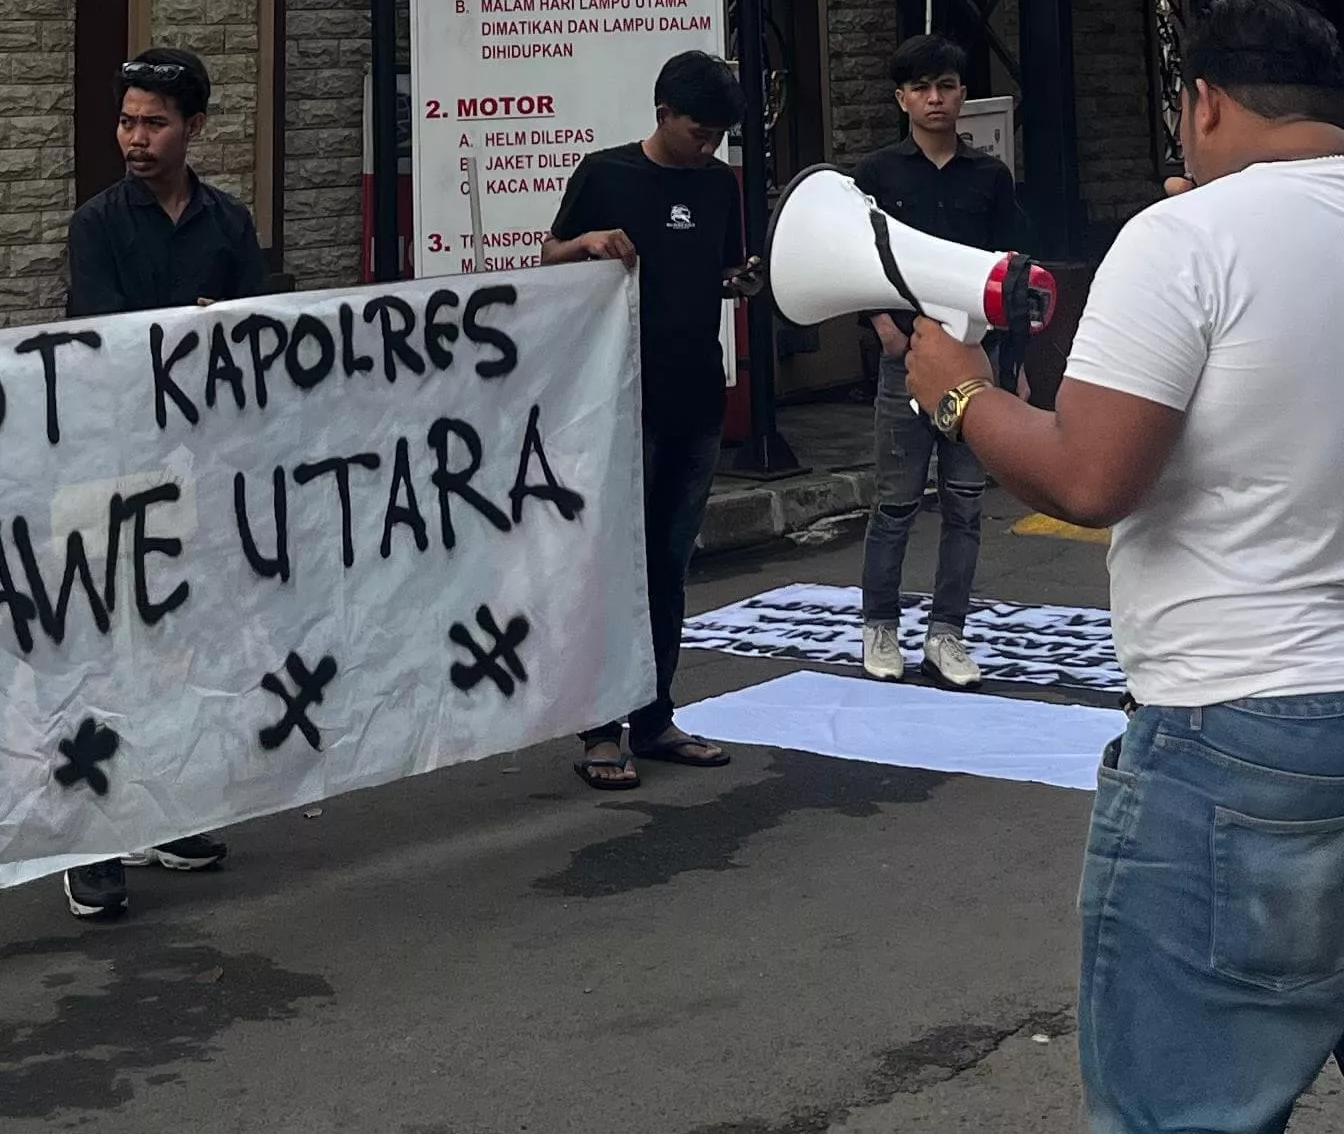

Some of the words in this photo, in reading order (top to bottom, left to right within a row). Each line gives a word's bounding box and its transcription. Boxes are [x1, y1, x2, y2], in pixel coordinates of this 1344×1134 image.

[481, 20, 563, 36] DIMATIKAN
[567, 19, 599, 34] DAN
[604, 17, 655, 33] LAMPU
[658, 16, 711, 32] DALAM
[481, 43, 574, 60] DIHIDUPKAN
[425, 101, 449, 119] 2.
[456, 95, 555, 117] MOTOR
[485, 131, 527, 147] HELM
[531, 129, 595, 145] DILEPAS
[485, 154, 534, 171] JAKET
[486, 179, 529, 194] KACA
[428, 234, 451, 252] 3.
[461, 256, 516, 274] MSUK
[148, 283, 520, 430] KAPOLRES
[233, 403, 586, 584] UTARA
